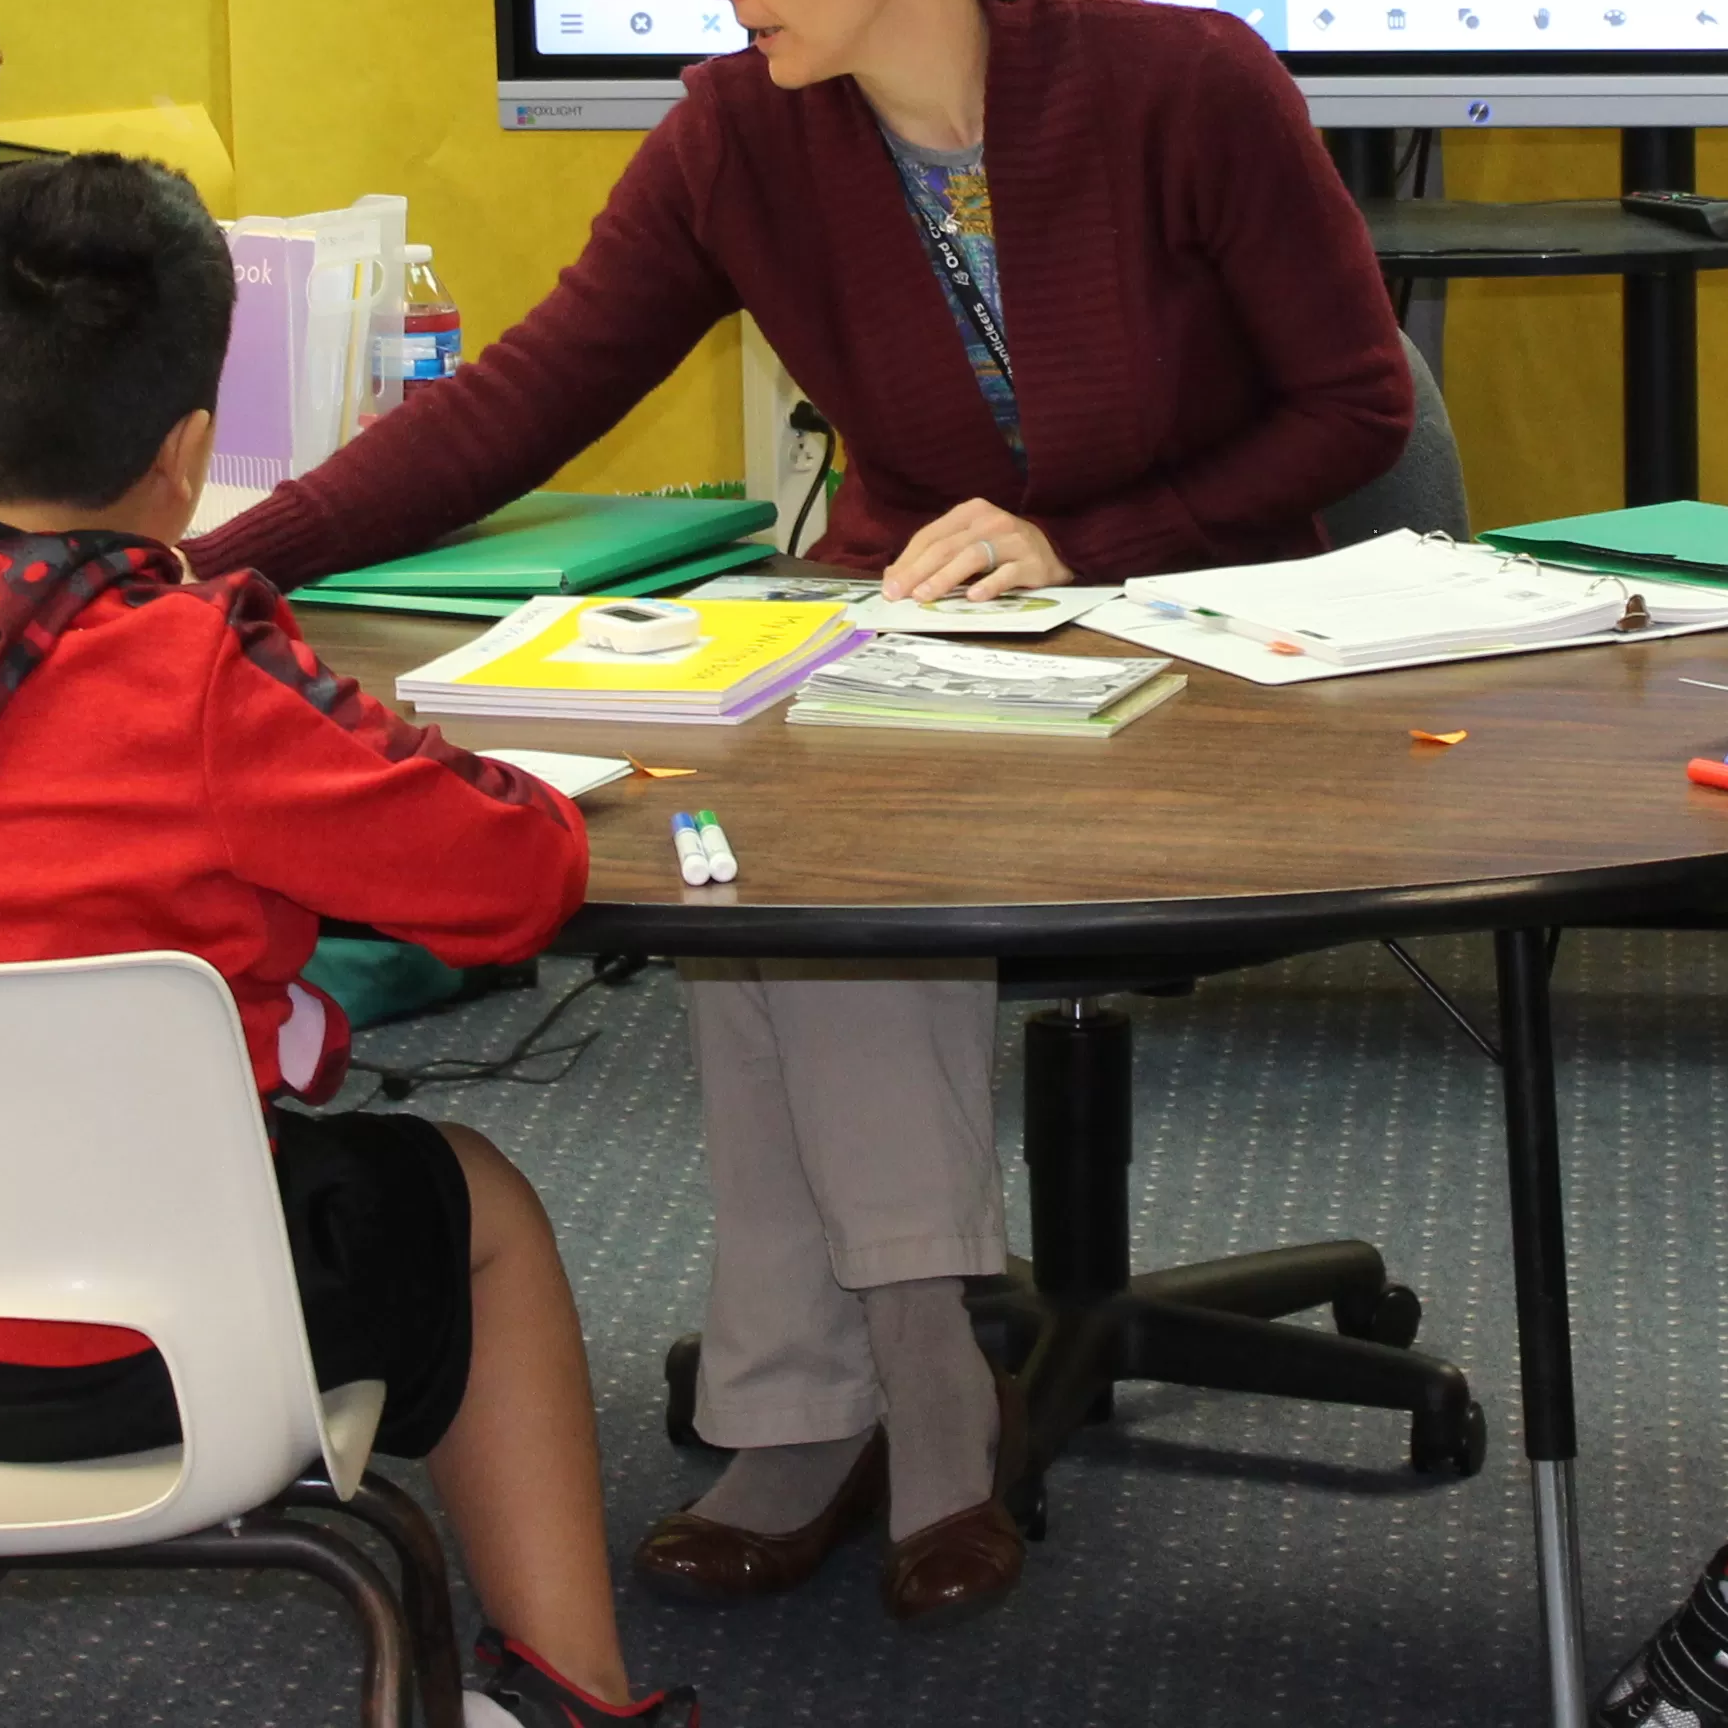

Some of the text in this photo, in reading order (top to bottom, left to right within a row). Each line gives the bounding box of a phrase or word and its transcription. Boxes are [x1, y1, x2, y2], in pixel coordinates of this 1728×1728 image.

[938, 242, 959, 269] Ord
[234, 258, 273, 285] ook
[973, 302, 1013, 378] anticleers
